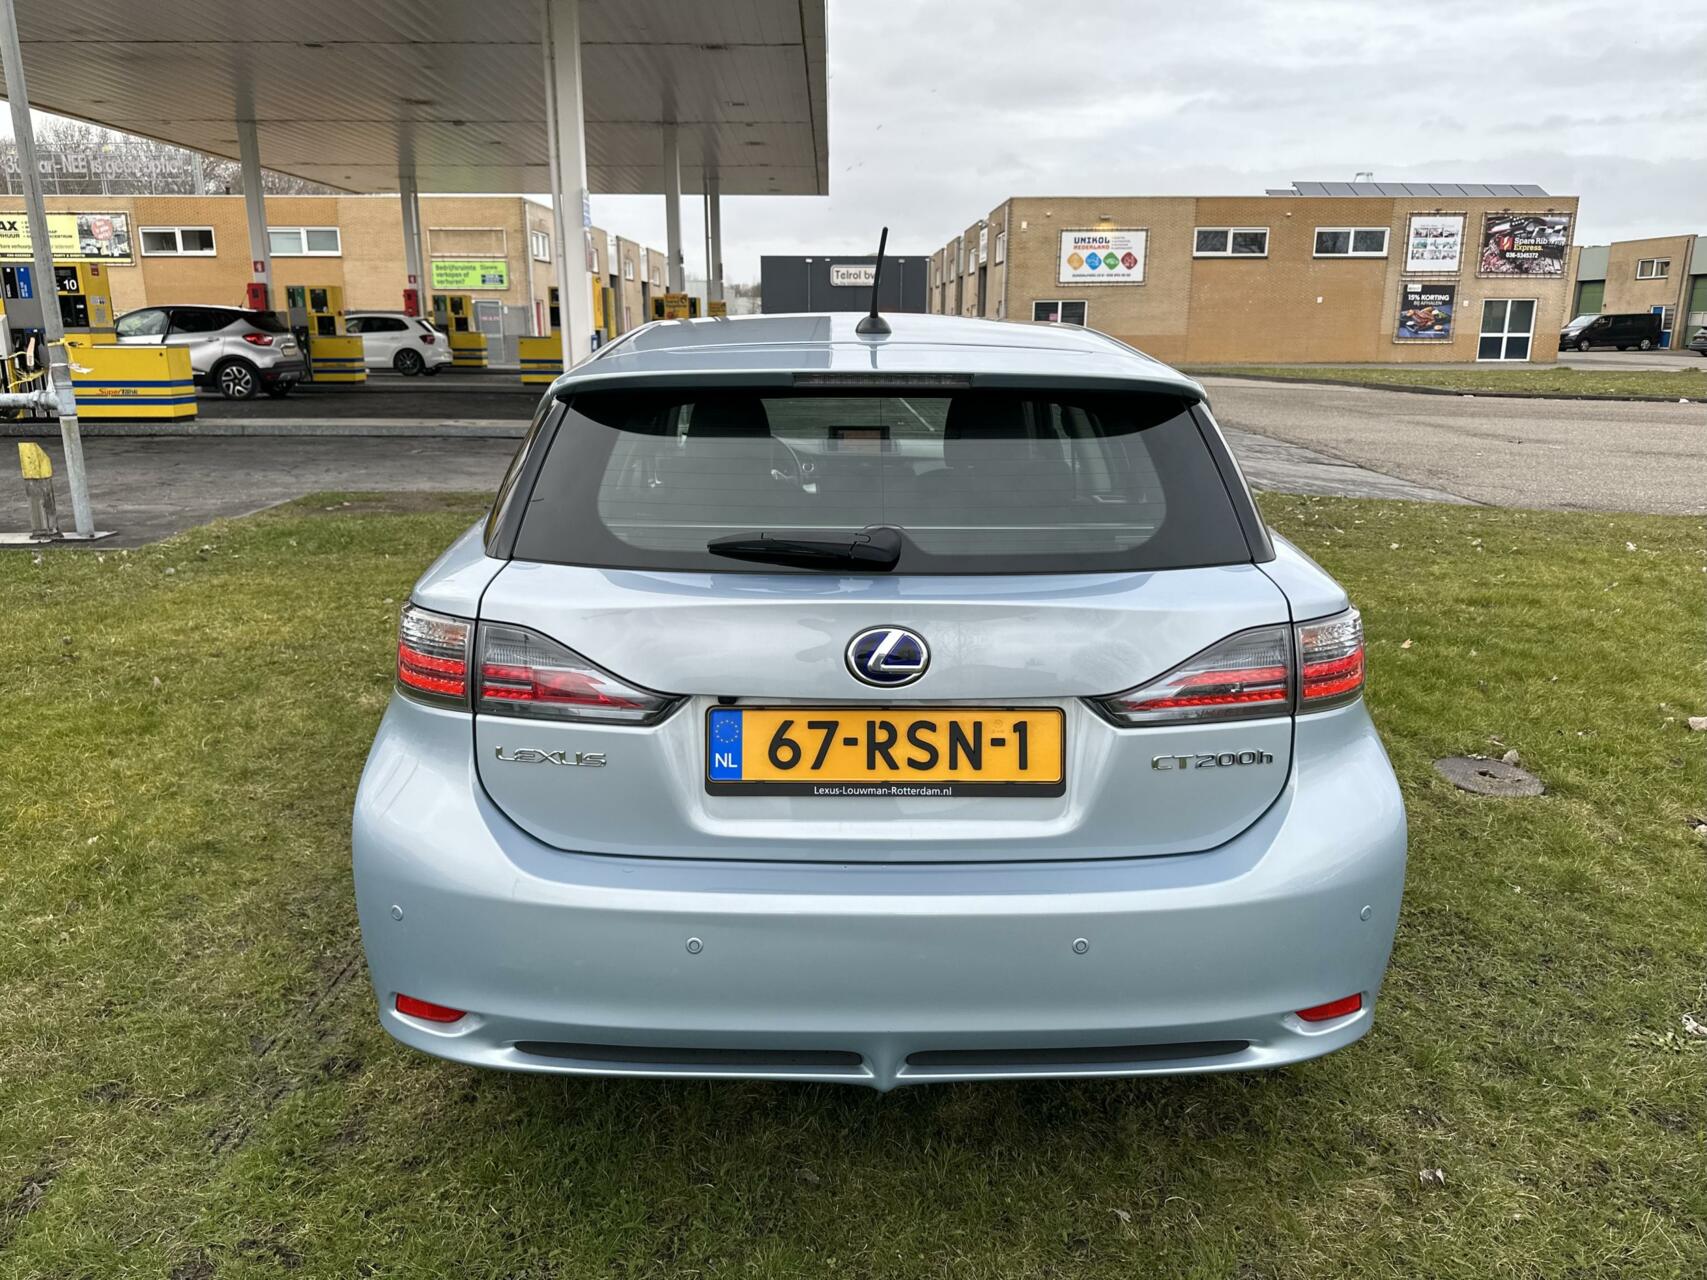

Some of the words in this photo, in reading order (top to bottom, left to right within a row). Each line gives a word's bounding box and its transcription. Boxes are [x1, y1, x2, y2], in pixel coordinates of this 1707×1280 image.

[1074, 236, 1110, 244] UNIKOL
[1536, 237, 1548, 245] Rib
[835, 270, 862, 280] Telrol
[63, 279, 77, 290] 10
[767, 719, 1028, 771] 67-RSN-1
[495, 745, 607, 768] LEXUS
[714, 752, 738, 768] NL
[1151, 747, 1274, 771] CT200h
[813, 786, 952, 796] Lexus-Louwman-Rotterdam.nl
